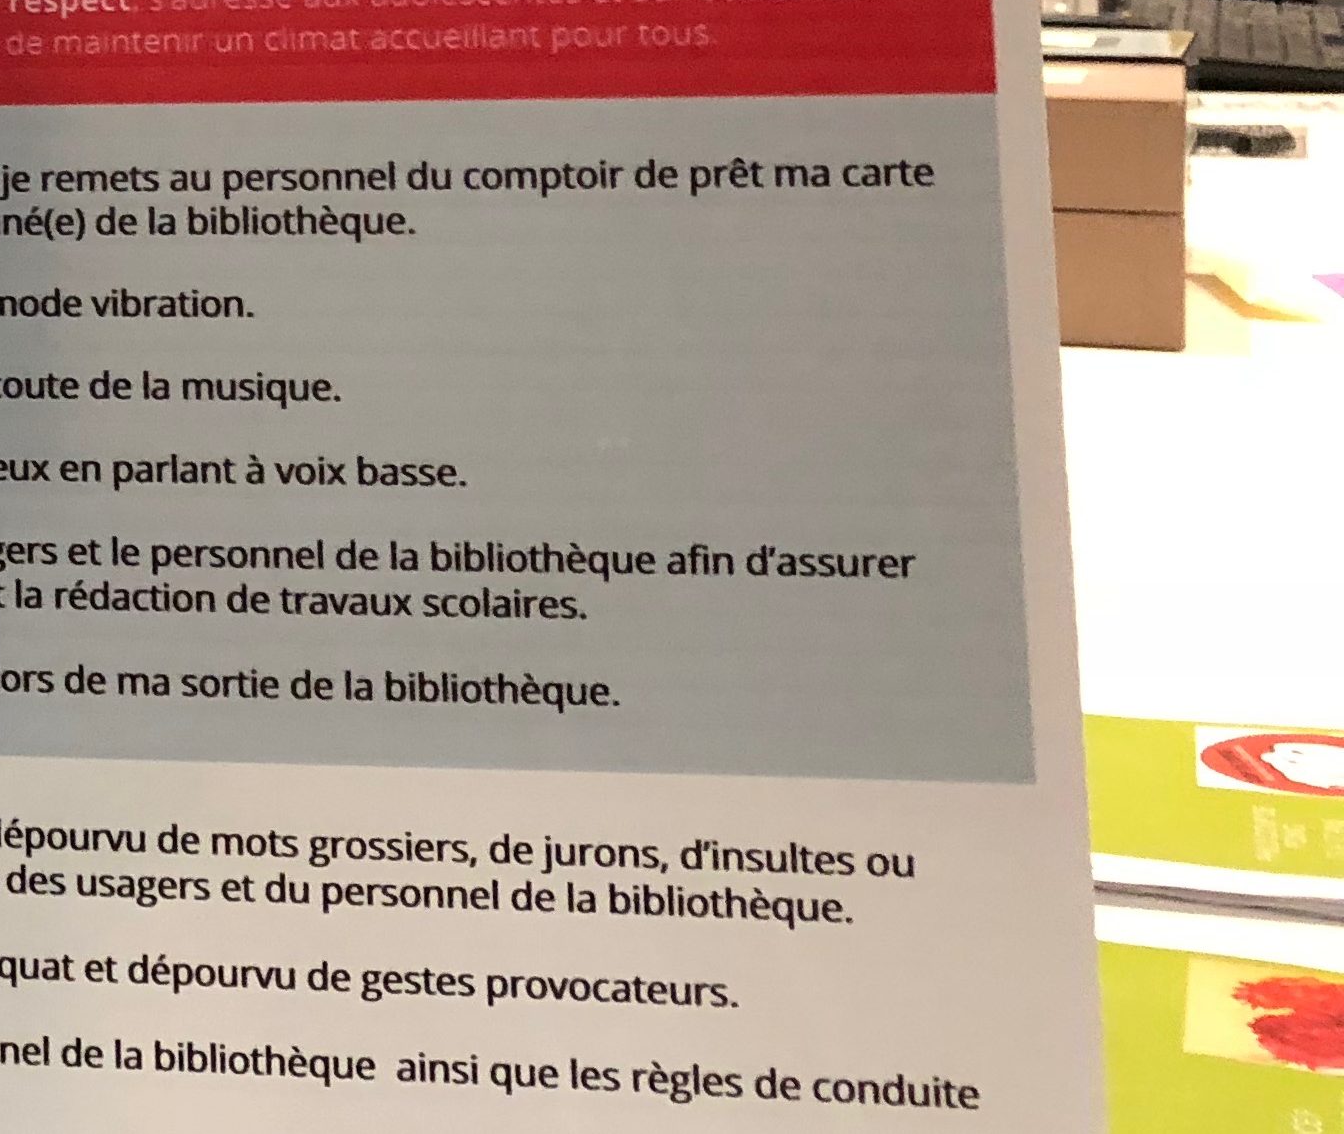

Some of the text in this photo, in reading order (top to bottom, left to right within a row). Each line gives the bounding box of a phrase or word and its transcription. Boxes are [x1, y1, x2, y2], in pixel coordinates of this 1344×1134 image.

[5, 32, 44, 56] de
[53, 31, 204, 55] maintenir
[214, 31, 254, 54] un
[264, 28, 361, 52] climat
[368, 25, 542, 51] accueillant
[551, 25, 628, 54] pour
[39, 165, 162, 194] remets
[168, 168, 213, 194] au
[221, 159, 398, 202] personnel
[405, 159, 453, 192] du
[461, 158, 626, 200] comptoir
[632, 157, 680, 191] de
[688, 155, 766, 199] prêt
[773, 163, 832, 189] ma
[840, 158, 936, 189] carte
[94, 204, 139, 238] de
[146, 204, 178, 238] la
[186, 203, 417, 245] bibliothèque.
[87, 368, 134, 402] de
[141, 368, 172, 402] la
[180, 370, 343, 411] musique.
[66, 538, 104, 568] et
[110, 534, 142, 569] le
[149, 537, 326, 578] personnel
[333, 537, 381, 573] de
[388, 538, 421, 573] la
[429, 539, 658, 584] bibliothèque
[665, 542, 736, 577] afin
[744, 543, 918, 580] d'assurer
[13, 576, 44, 611] la
[53, 578, 218, 614] rédaction
[225, 581, 272, 616] de
[277, 586, 414, 618] travaux
[421, 585, 589, 622] scolaires.
[155, 821, 202, 857] de
[209, 828, 301, 860] mots
[306, 829, 479, 870] grossiers,
[487, 831, 535, 867] de
[539, 833, 670, 876] jurons,
[678, 837, 857, 878] d'insultes
[864, 851, 917, 880] ou
[4, 861, 69, 898] des
[74, 872, 213, 910] usagers
[219, 873, 258, 905] et
[263, 870, 312, 906] du
[319, 877, 501, 916] personnel
[509, 878, 558, 915] de
[565, 879, 598, 916] la
[606, 881, 855, 932] bibliothèque.
[59, 1035, 106, 1071] de
[112, 1036, 145, 1072] la
[152, 1038, 378, 1089] bibliothèque
[394, 1050, 480, 1087] ainsi
[488, 1061, 561, 1097] que
[568, 1056, 623, 1094] les
[630, 1059, 745, 1106] règles
[752, 1065, 803, 1103] de
[810, 1072, 982, 1112] conduite
